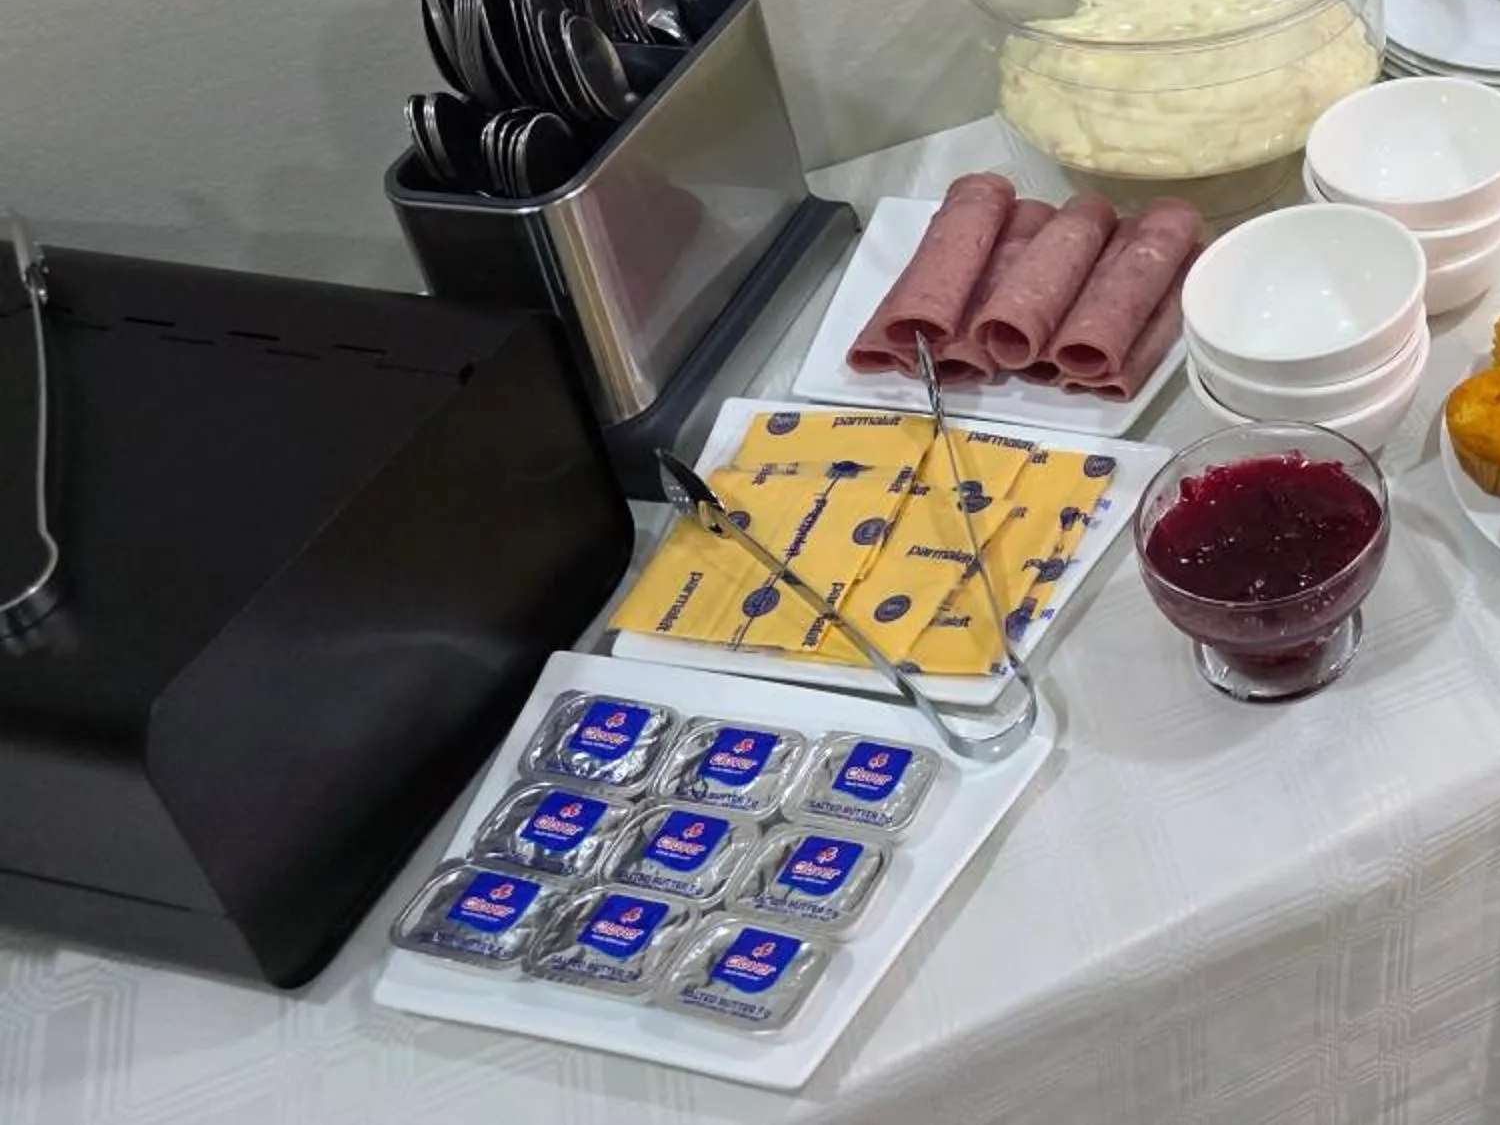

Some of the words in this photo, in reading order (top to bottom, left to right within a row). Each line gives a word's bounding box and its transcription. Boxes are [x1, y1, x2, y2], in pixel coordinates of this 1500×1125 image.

[831, 415, 902, 429] parmalat
[655, 571, 704, 632] parmalat
[580, 726, 632, 745] Clover
[708, 752, 758, 771] Clover
[844, 766, 894, 786] Clover
[532, 814, 585, 836] Clover
[655, 835, 707, 856] Clover
[791, 860, 842, 880] Clover
[460, 896, 516, 917] Clover
[591, 920, 645, 940] Clover
[724, 954, 777, 976] Clover
